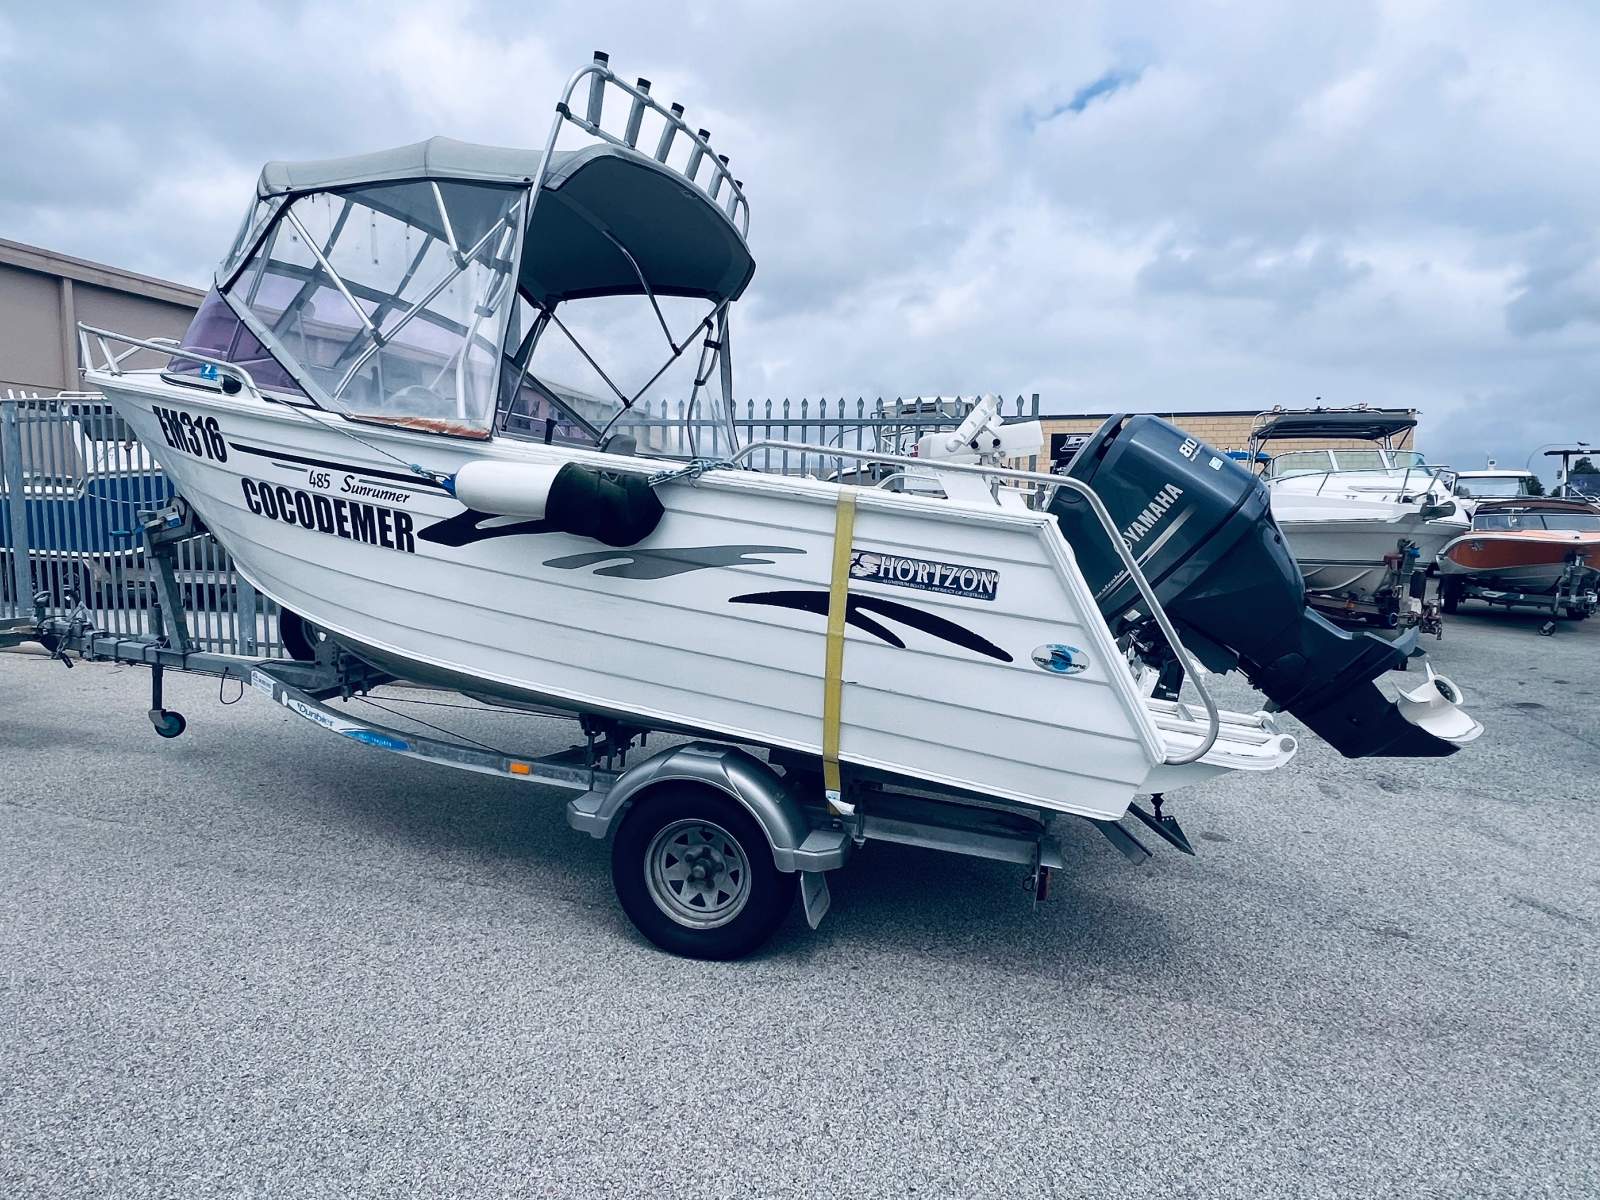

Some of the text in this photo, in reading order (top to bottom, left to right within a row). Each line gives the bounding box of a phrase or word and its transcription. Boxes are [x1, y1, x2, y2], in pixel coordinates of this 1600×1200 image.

[151, 404, 228, 463] EM316
[1179, 437, 1198, 458] 80
[308, 470, 410, 503] 485 Sunrunner
[241, 477, 415, 554] COCODEMER
[1123, 483, 1184, 542] YAMAHA
[878, 556, 997, 594] HORIZON
